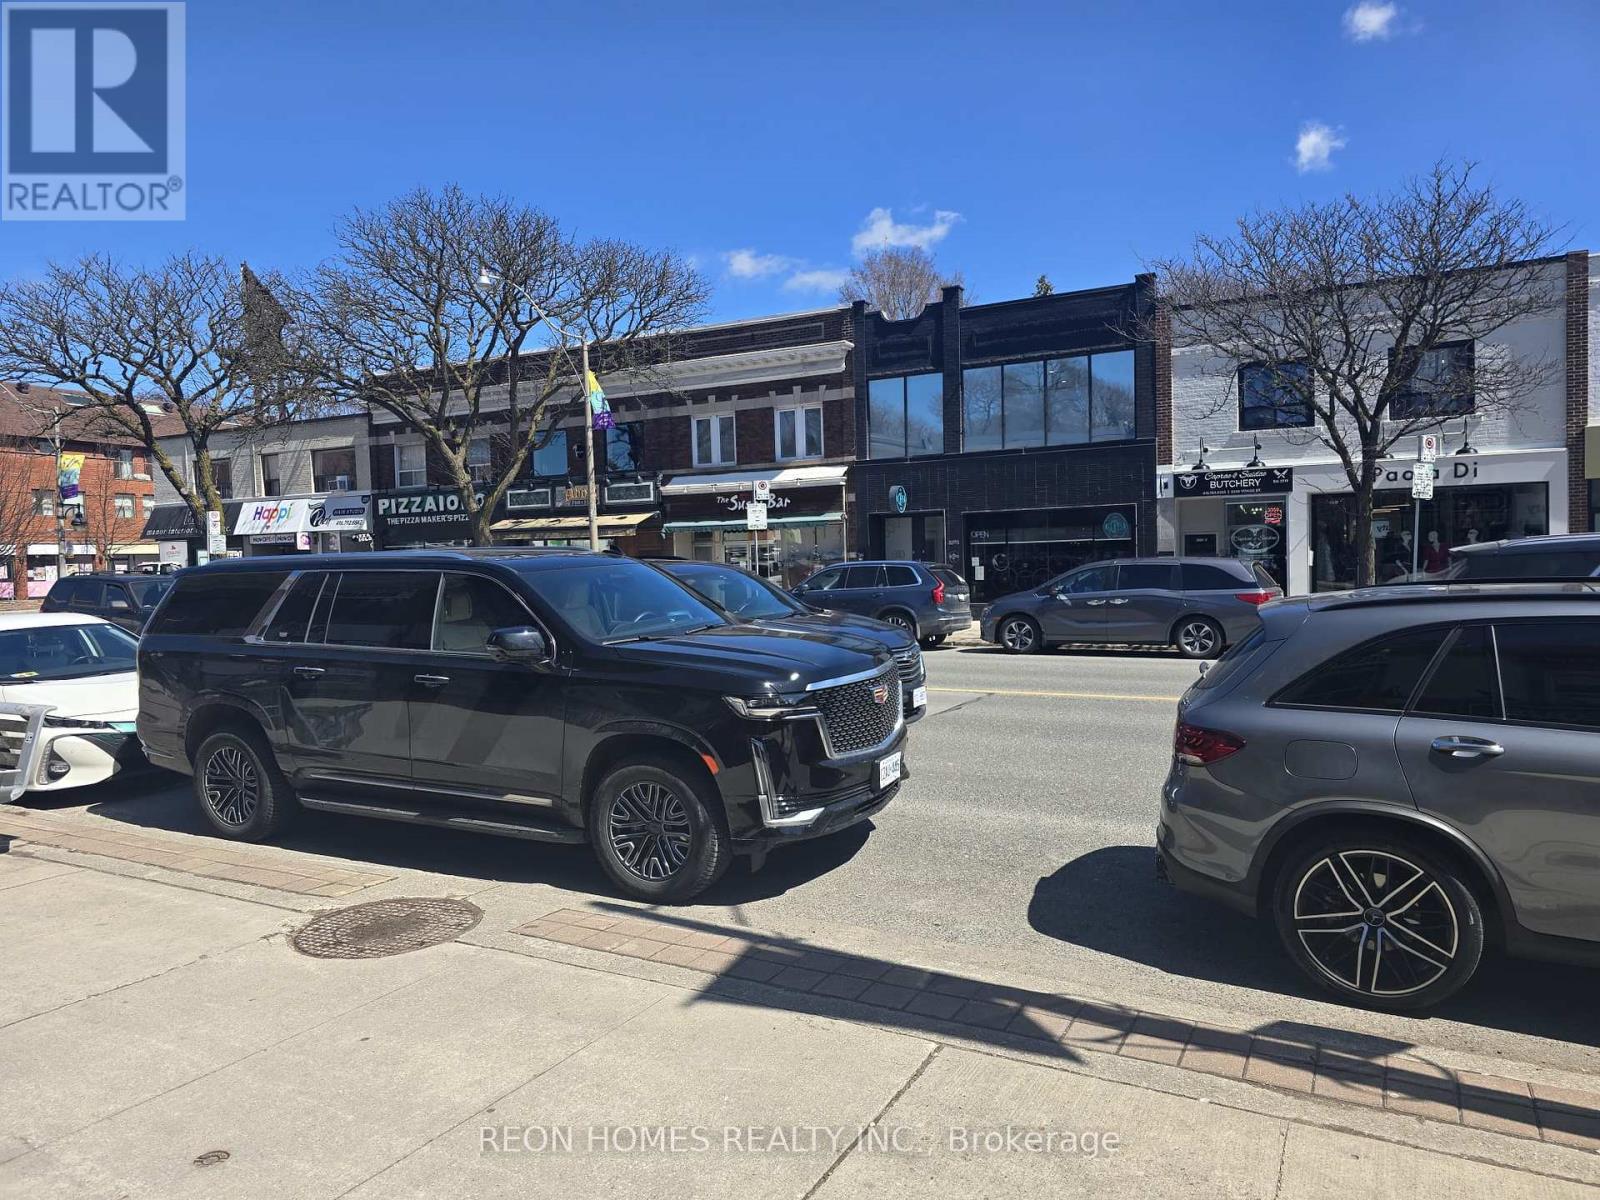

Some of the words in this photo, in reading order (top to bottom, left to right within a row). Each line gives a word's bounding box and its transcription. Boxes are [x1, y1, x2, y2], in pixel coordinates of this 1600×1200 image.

[1374, 466, 1439, 482] Paoa
[1455, 461, 1478, 479] Di
[1209, 478, 1262, 489] BUTCHERY
[378, 492, 484, 515] PIZZAIOO
[727, 494, 763, 511] Sus
[767, 492, 791, 509] Bar
[253, 503, 292, 521] Happi
[387, 517, 400, 526] THE
[400, 516, 420, 525] PIZZA
[420, 514, 453, 524] MAKER'S
[453, 513, 470, 522] PIZZ
